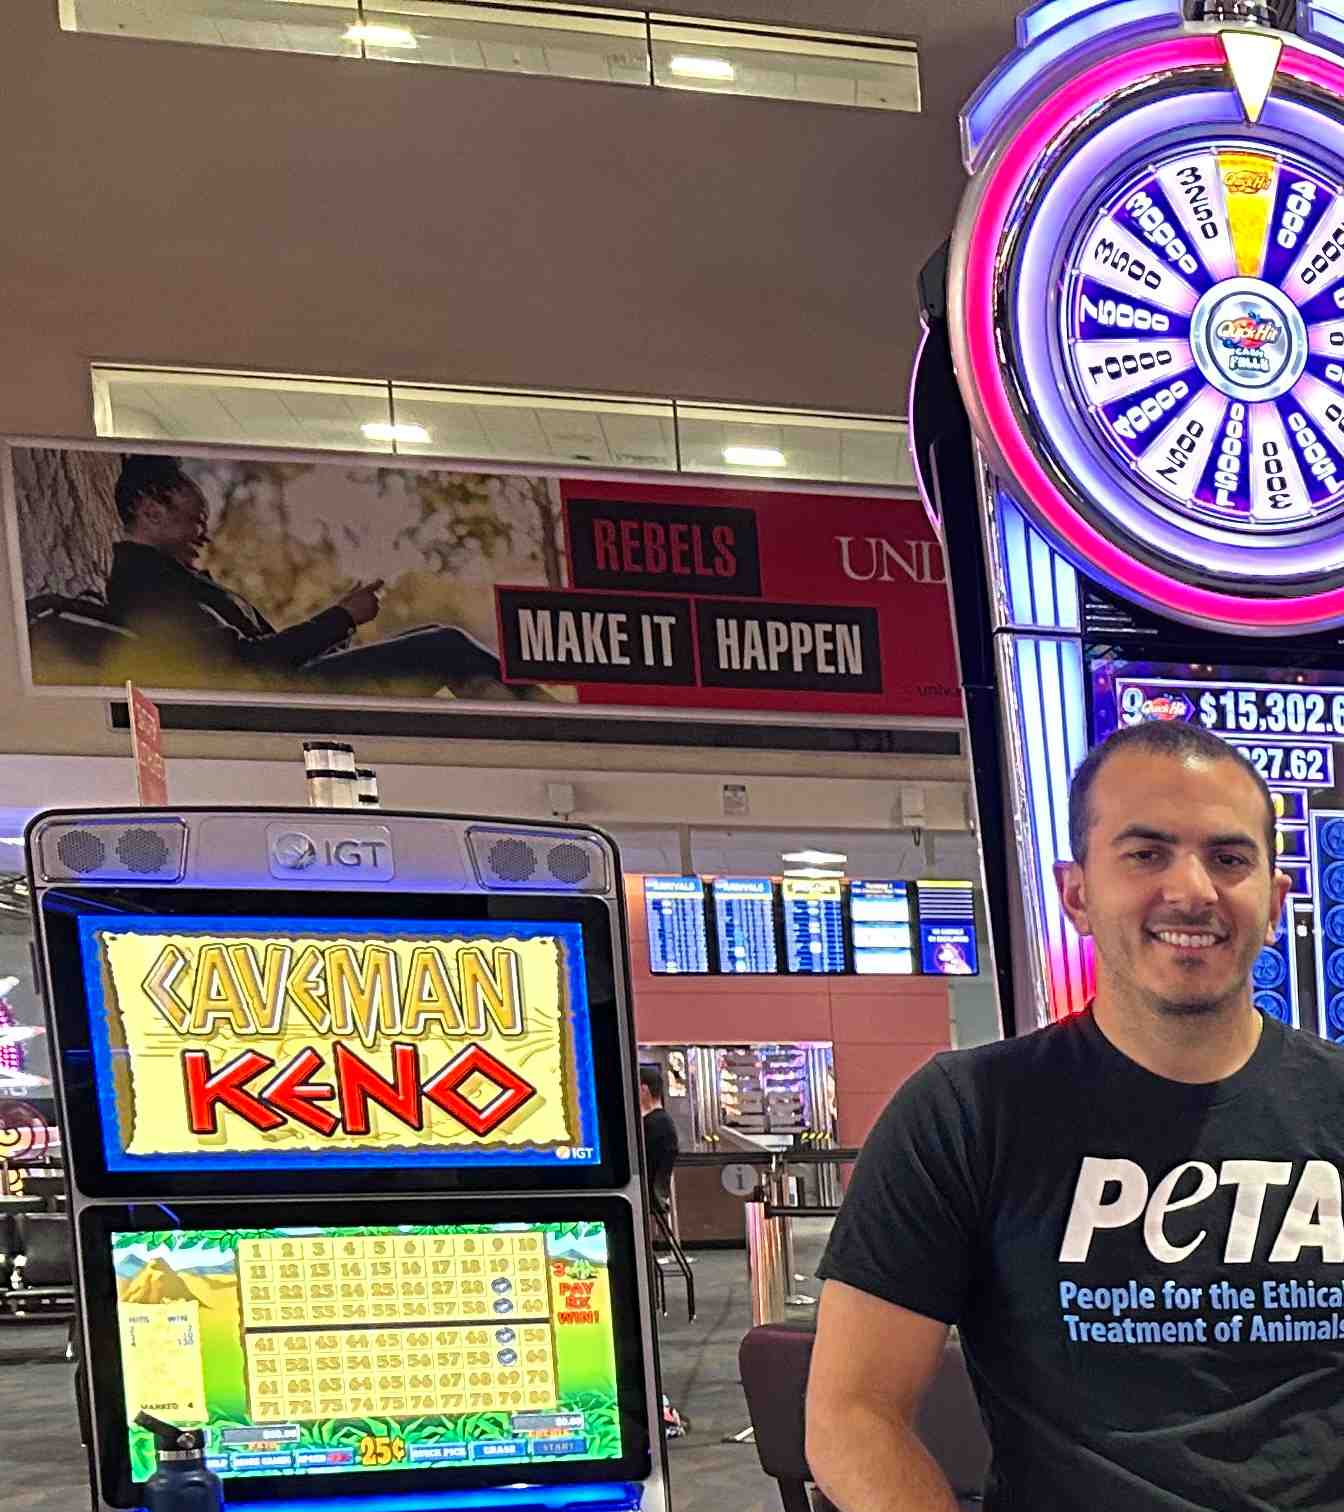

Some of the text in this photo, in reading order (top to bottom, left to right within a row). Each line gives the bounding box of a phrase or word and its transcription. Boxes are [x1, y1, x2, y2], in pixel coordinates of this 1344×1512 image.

[1176, 166, 1220, 240] 3250
[1276, 179, 1318, 249] 4000
[1124, 190, 1199, 275] 30000
[1094, 237, 1162, 290] 3500
[1078, 294, 1170, 332] 75000
[1087, 349, 1173, 385] 10000
[1110, 380, 1190, 440] 40000
[1156, 419, 1204, 485] 7500
[1213, 402, 1245, 508] 150000
[1262, 441, 1293, 510] 3000
[593, 518, 737, 579] REBELS
[518, 610, 677, 669] MAKE IT
[716, 617, 863, 677] HAPPEN
[1237, 747, 1323, 781] 27.62
[324, 840, 385, 869] IGT
[141, 943, 526, 1049] CAVEMAN
[182, 1041, 537, 1137] KENO
[572, 1147, 593, 1159] IGT
[252, 1240, 416, 1258] 1 2 3 4 5 6
[553, 1262, 566, 1277] 3
[559, 1282, 594, 1296] PAY
[1059, 1281, 1155, 1316] People
[1162, 1281, 1202, 1309] for
[1209, 1281, 1255, 1309] the
[557, 1312, 599, 1325] WIN!
[1064, 1315, 1207, 1343] Treatment
[1214, 1315, 1243, 1341] of
[360, 1434, 405, 1466] 25¢
